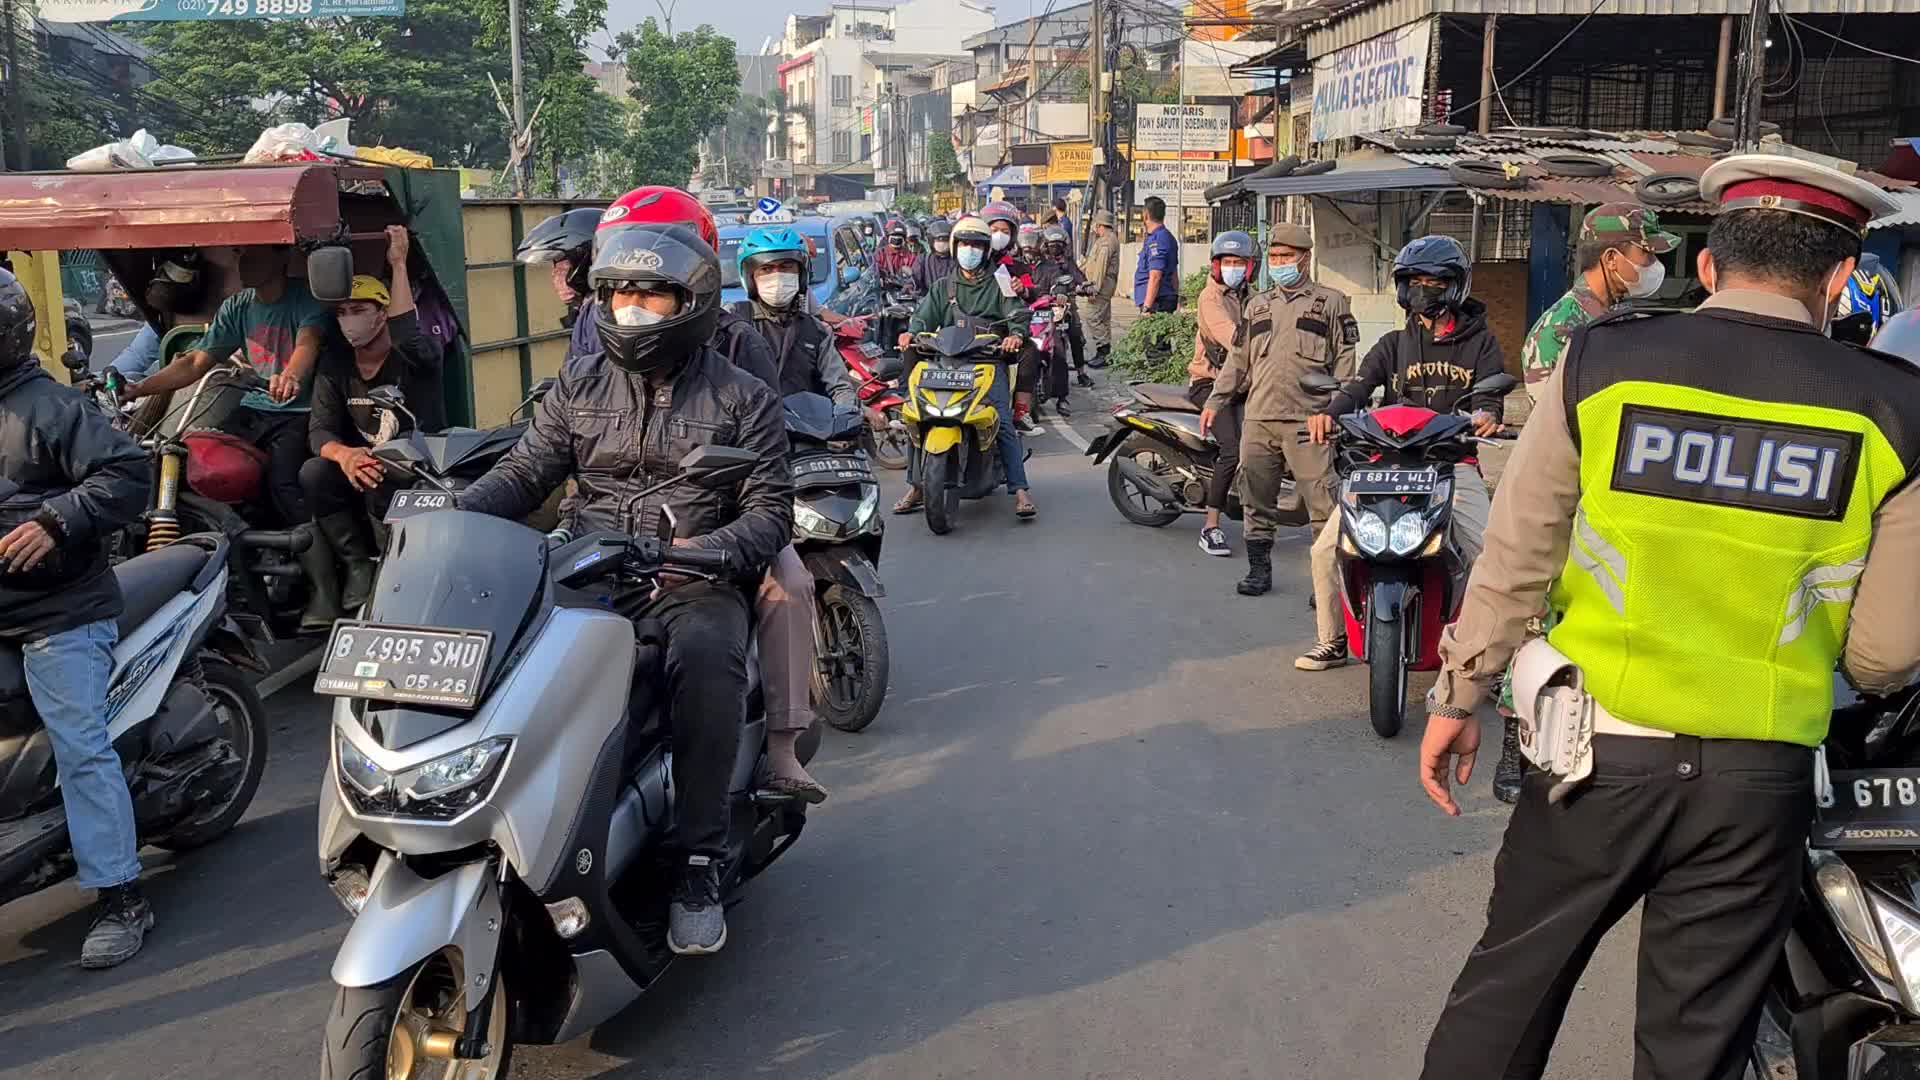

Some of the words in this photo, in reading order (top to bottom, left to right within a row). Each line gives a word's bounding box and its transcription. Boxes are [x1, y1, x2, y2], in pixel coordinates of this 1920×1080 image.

[206, 0, 249, 16] 749
[255, 0, 313, 15] 8898
[1163, 106, 1204, 116] NOTARIS
[1625, 422, 1841, 500] POLISI
[1353, 473, 1361, 482] B
[1366, 472, 1400, 482] 6814
[1407, 472, 1433, 482] WLI
[397, 495, 408, 507] B
[413, 495, 446, 507] 4540
[335, 633, 354, 658] B
[365, 635, 424, 664] 4995
[429, 640, 480, 668] SMU
[327, 679, 359, 690] YAMAHA
[1853, 777, 1920, 807] 678
[1844, 829, 1919, 838] HONDA
